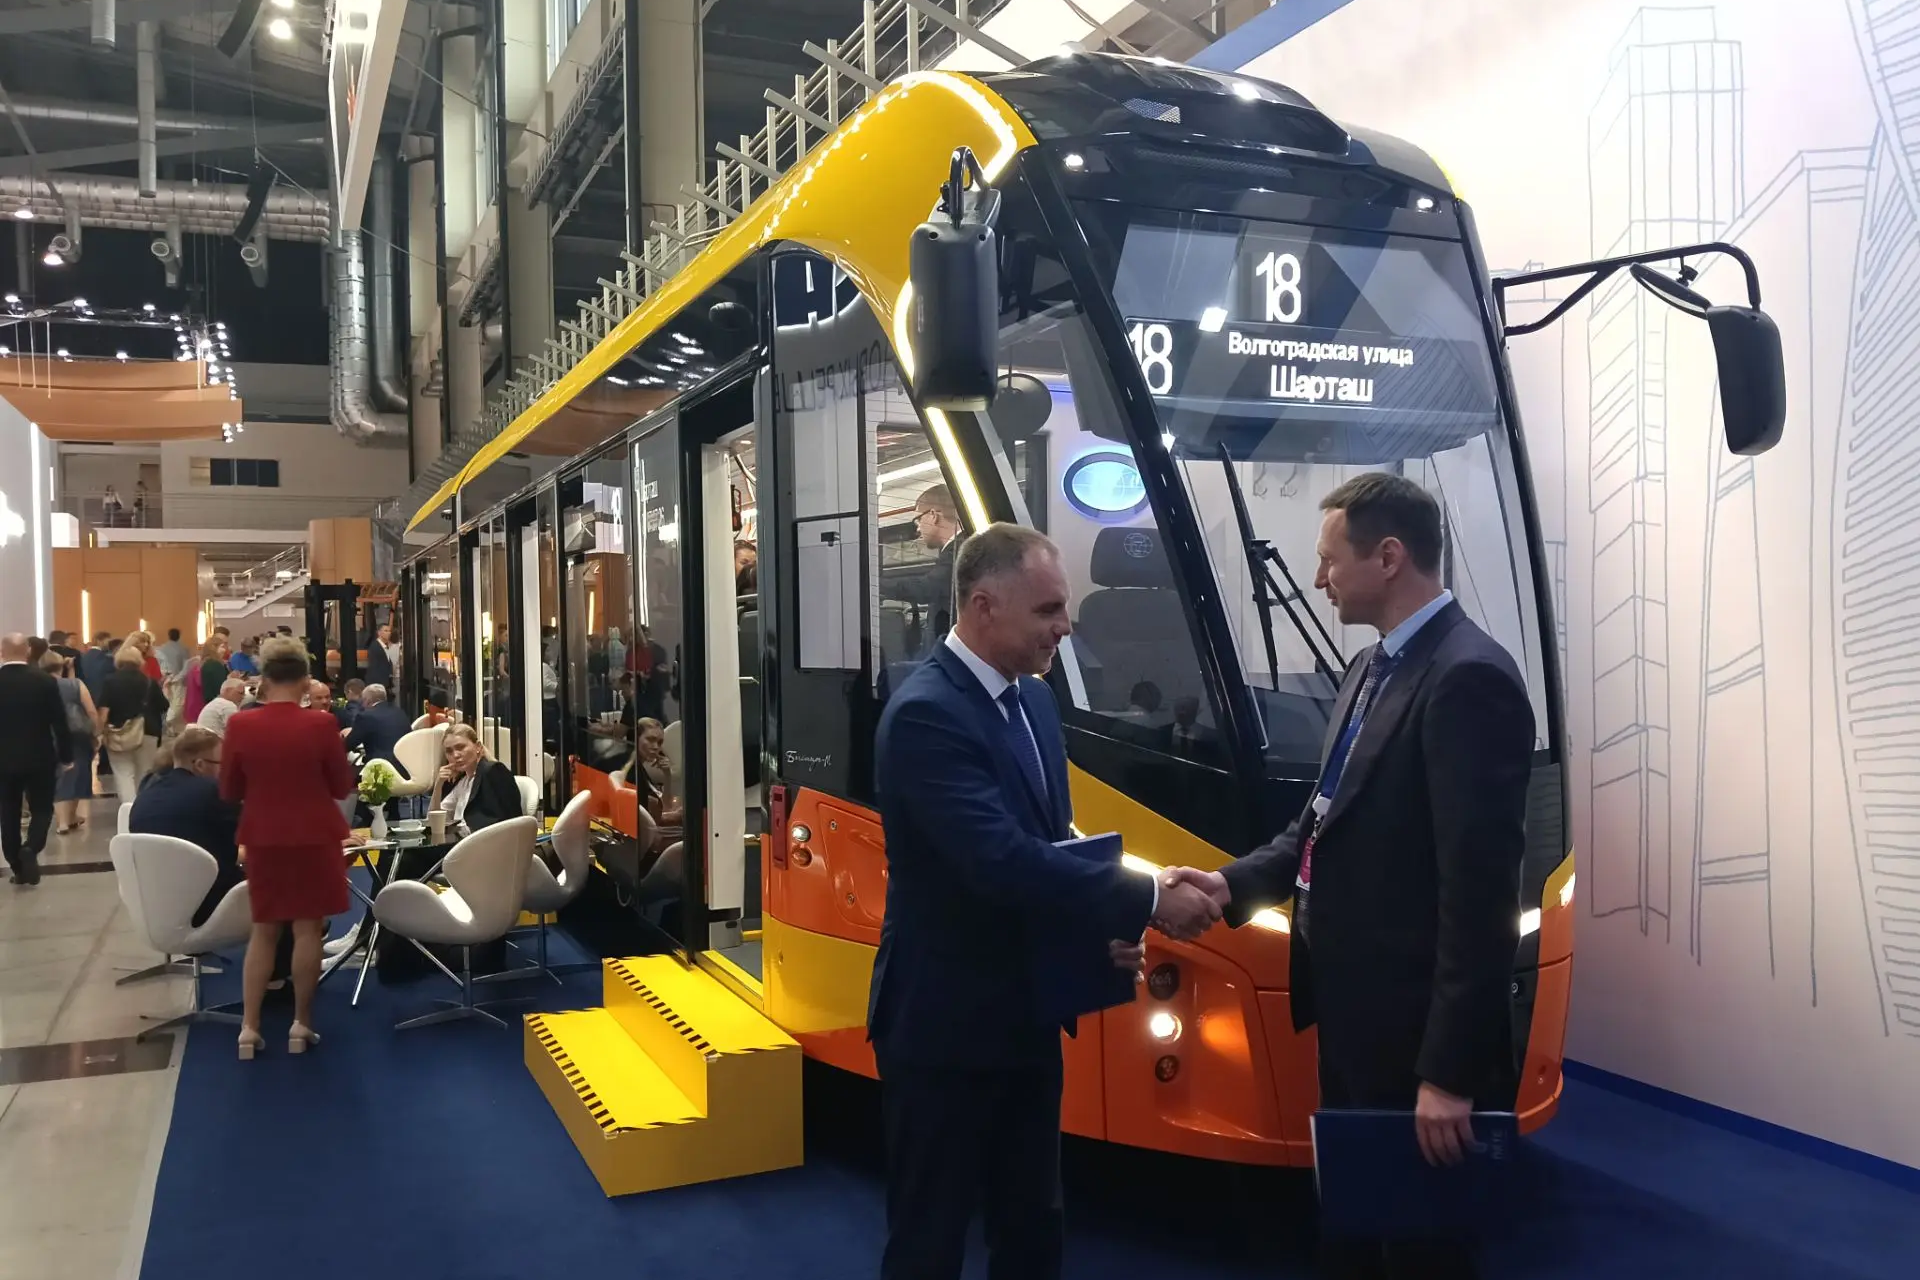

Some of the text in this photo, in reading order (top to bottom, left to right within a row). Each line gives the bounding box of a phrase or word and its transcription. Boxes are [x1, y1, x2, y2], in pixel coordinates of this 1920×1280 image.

[1256, 252, 1301, 323] 18
[1129, 322, 1173, 394] 18
[1229, 331, 1414, 368] Волгоградская улица
[1270, 364, 1374, 402] Шарташ
